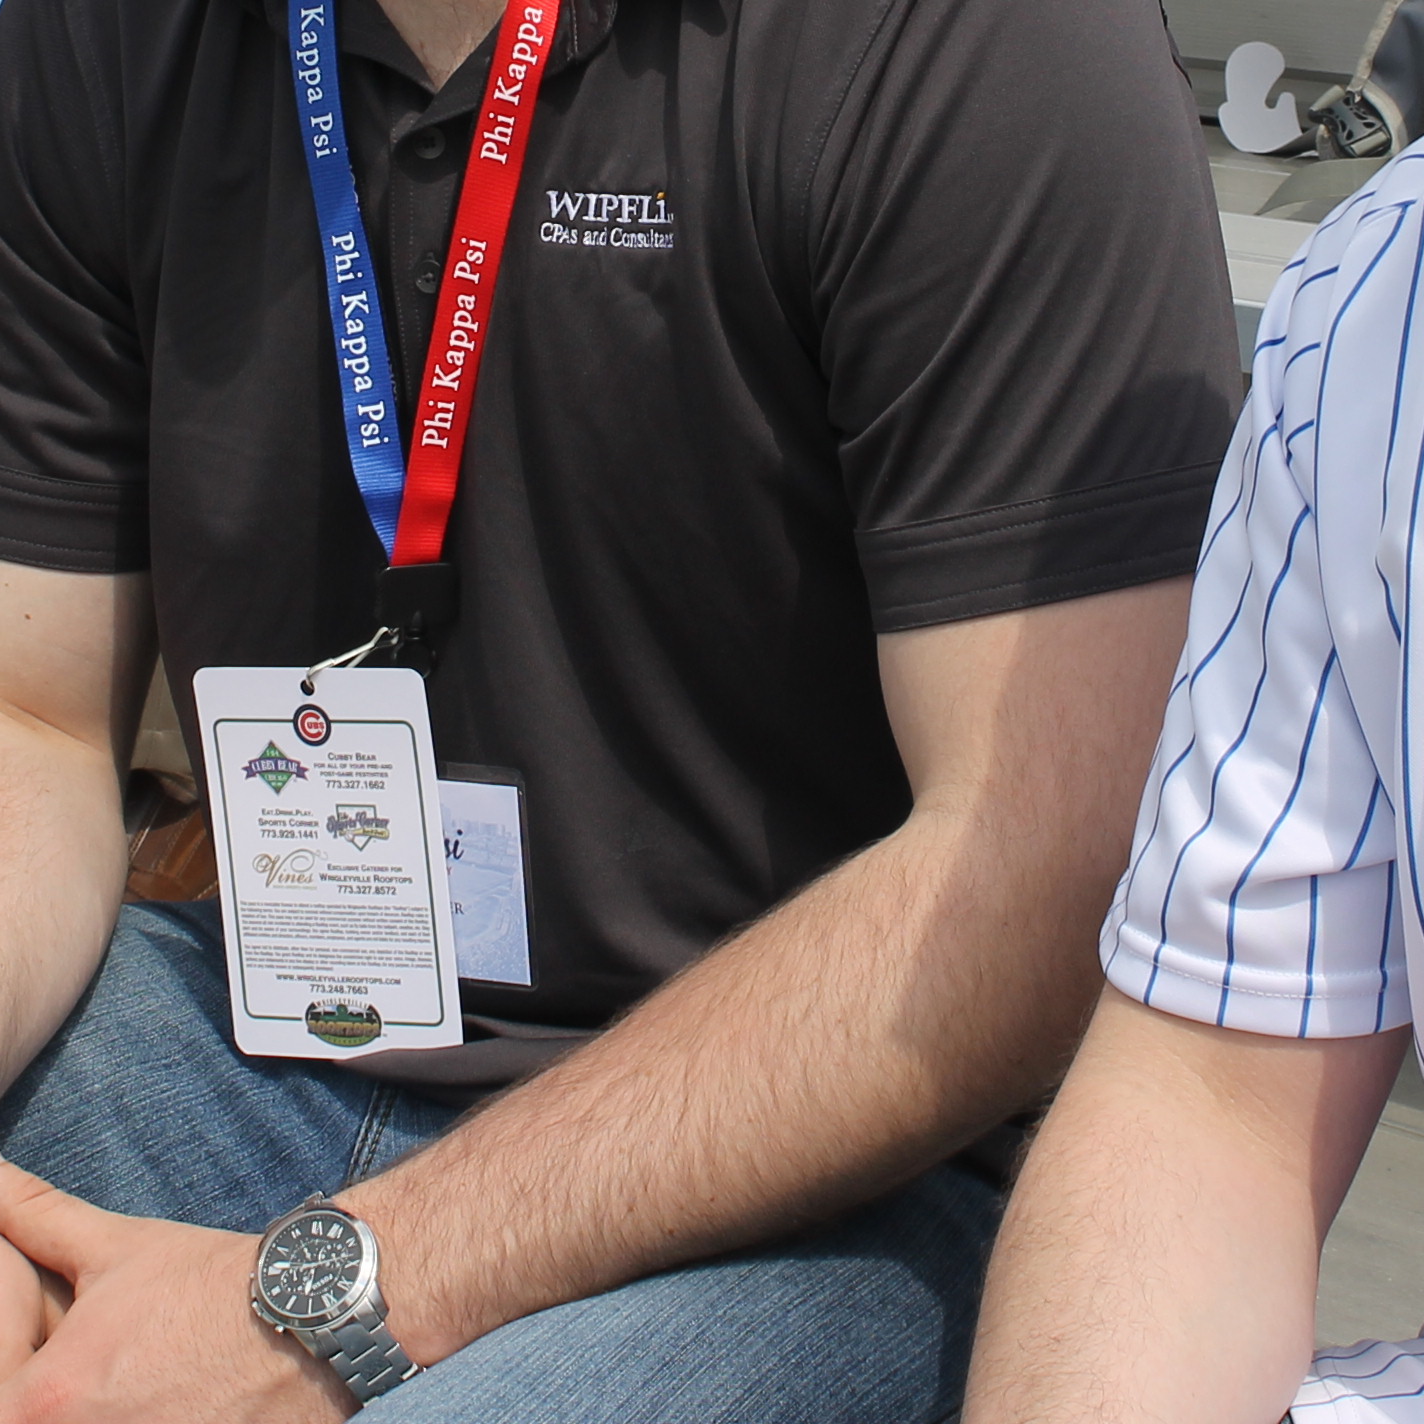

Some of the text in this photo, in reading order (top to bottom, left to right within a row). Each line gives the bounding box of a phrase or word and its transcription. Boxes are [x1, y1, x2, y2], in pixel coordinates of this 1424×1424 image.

[494, 6, 544, 106] Kappa
[296, 4, 324, 104] Kappa
[311, 112, 338, 159] Psi
[480, 112, 515, 164] Phi
[540, 222, 578, 245] CPAs
[582, 227, 607, 247] and
[331, 231, 389, 448] Phi Kappa Psi
[422, 237, 487, 449] Phi Kappa Psi
[300, 712, 326, 739] CUBS
[260, 829, 318, 839] 773.929.1441
[444, 829, 464, 860] si
[253, 848, 326, 888] Vines
[337, 885, 397, 896] 773.327.8572
